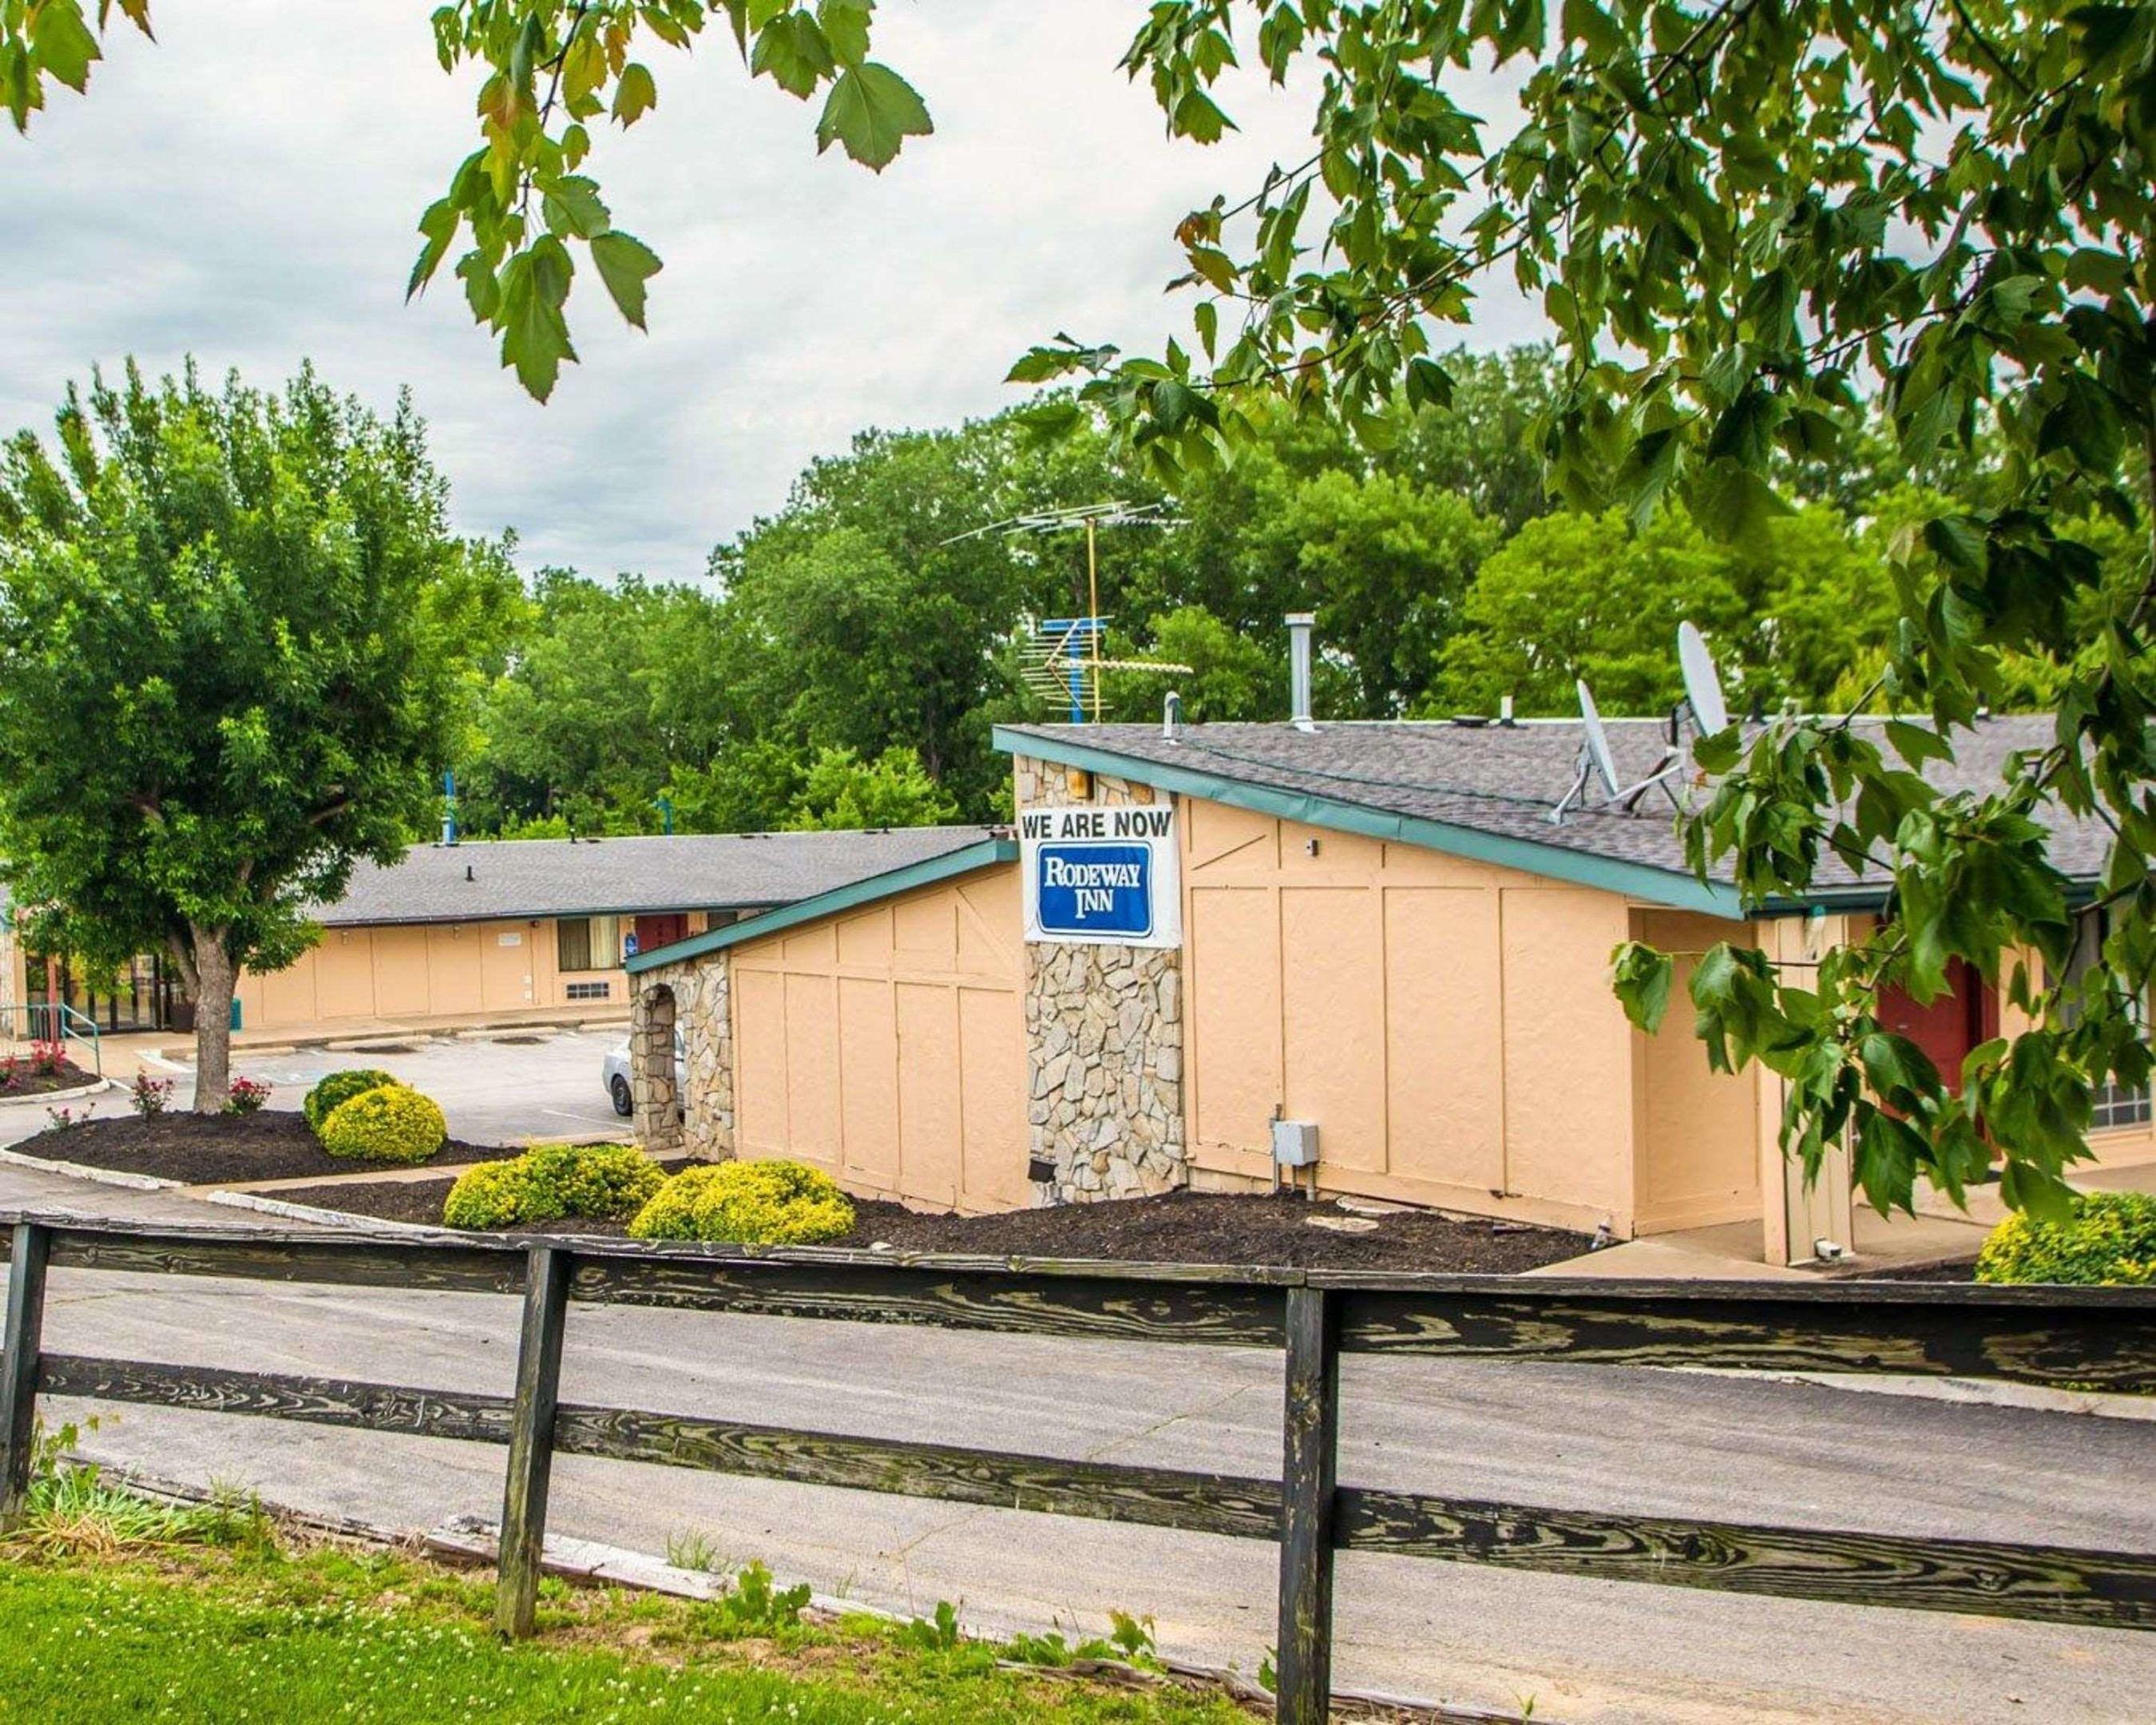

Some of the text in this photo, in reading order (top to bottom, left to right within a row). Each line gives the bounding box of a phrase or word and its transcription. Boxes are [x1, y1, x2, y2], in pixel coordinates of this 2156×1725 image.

[1022, 811, 1172, 839] WE ARE NOW
[1044, 857, 1141, 887] RODEWAY
[1075, 889, 1114, 919] INN
